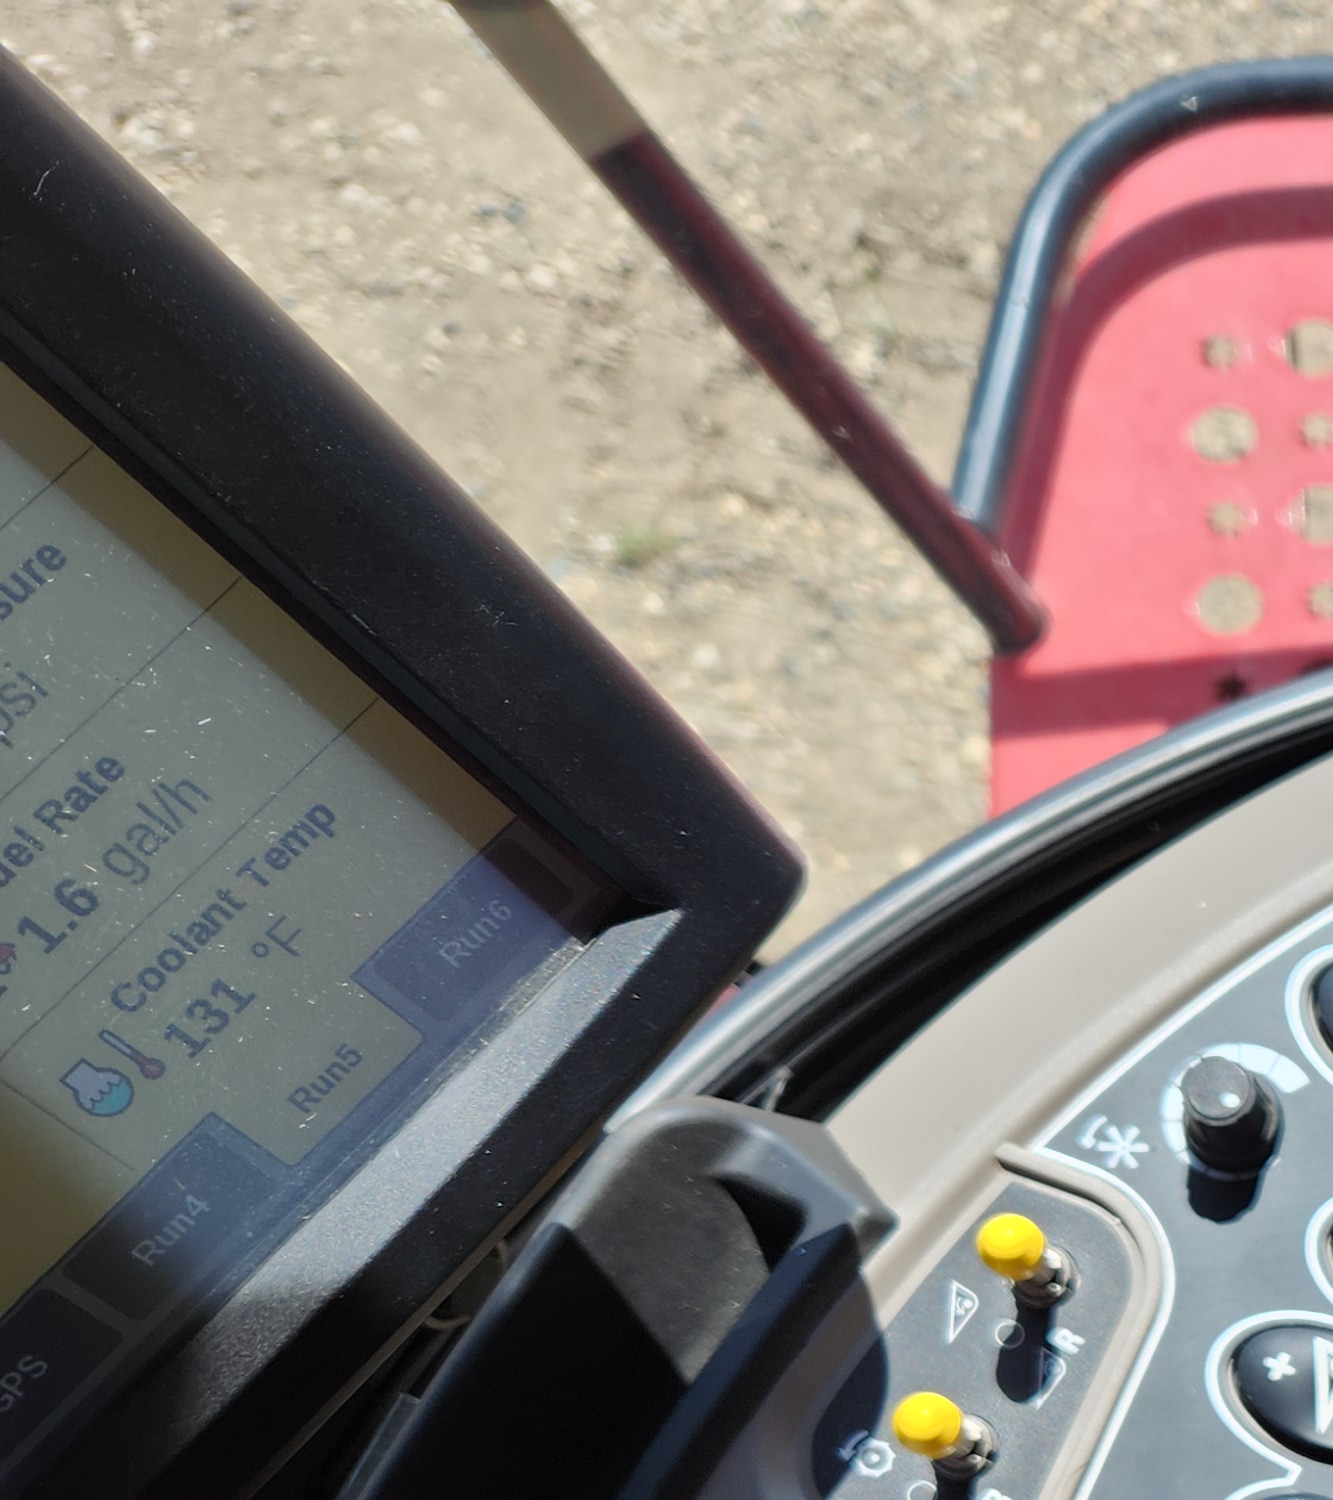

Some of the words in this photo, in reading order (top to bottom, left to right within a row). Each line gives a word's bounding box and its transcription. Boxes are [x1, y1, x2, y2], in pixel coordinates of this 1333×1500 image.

[32, 755, 125, 835] Rate
[17, 877, 100, 954] 1.6
[102, 778, 212, 885] gal/h
[110, 888, 248, 1013] Coolant
[234, 803, 336, 888] Temp
[439, 899, 513, 969] Run6
[163, 977, 257, 1059] 131
[286, 1043, 363, 1115] Run5
[131, 1193, 211, 1267] Run4
[1045, 1325, 1087, 1355] R
